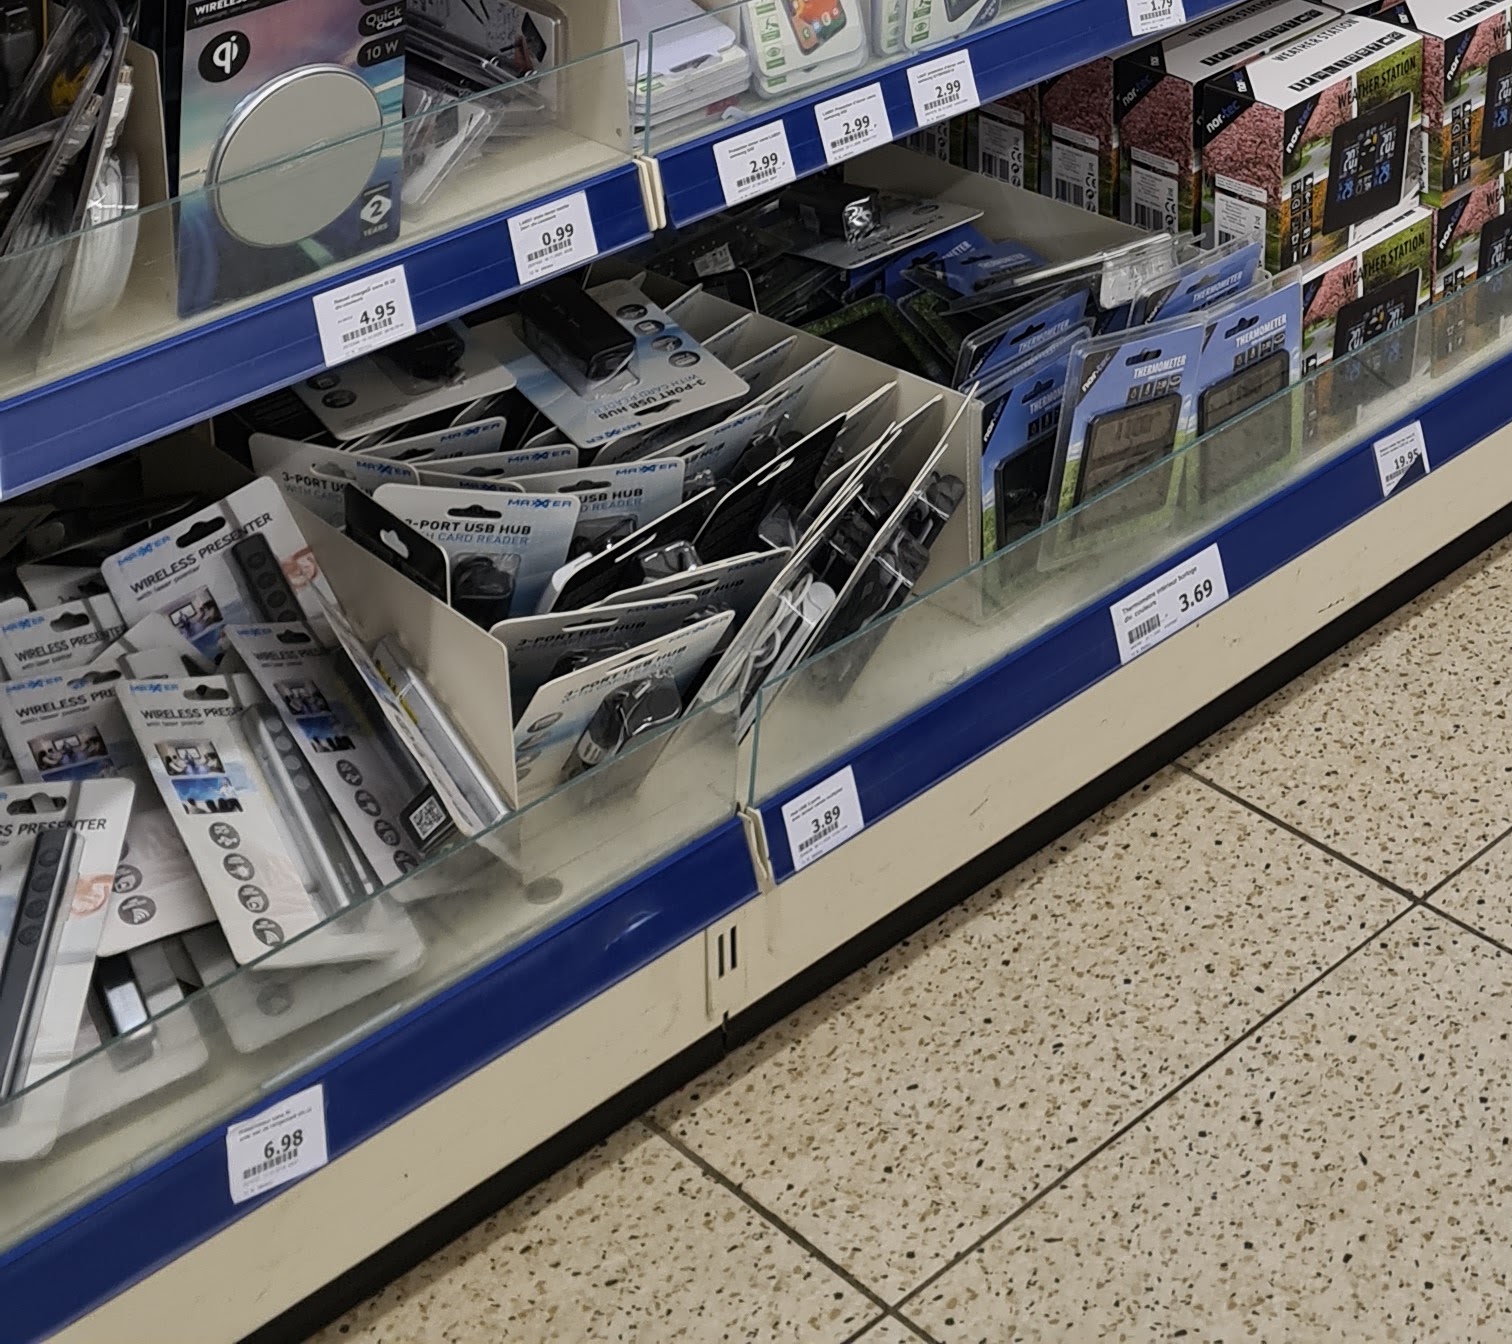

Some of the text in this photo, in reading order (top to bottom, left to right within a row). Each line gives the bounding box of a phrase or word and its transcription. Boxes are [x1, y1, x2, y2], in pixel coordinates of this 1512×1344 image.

[365, 5, 402, 27] Quick
[366, 39, 399, 61] 10 W
[1272, 17, 1358, 64] WEATHER STATION
[935, 80, 961, 99] 2.99
[1337, 54, 1418, 109] WEATHER STATION
[843, 115, 871, 135] 2.99
[750, 152, 778, 174] 2.99
[542, 223, 575, 246] 0.99
[1341, 230, 1427, 289] WEATHER STATION
[359, 300, 396, 326] 4.95
[1018, 319, 1071, 353] THERMOMETER
[1236, 313, 1288, 347] THERMOMETER
[1133, 353, 1188, 379] THERMOMETER
[437, 531, 529, 545] CARD READER
[463, 523, 496, 535] USB
[500, 524, 531, 535] HUB
[129, 511, 274, 595] WIRELESS PRESENTER
[1177, 579, 1214, 614] 3.69
[14, 641, 69, 664] WIRELESS
[15, 695, 87, 718] WIRELESS
[140, 708, 202, 720] WIRELESS
[811, 805, 842, 834] 3.89
[263, 1129, 304, 1159] 6.98
